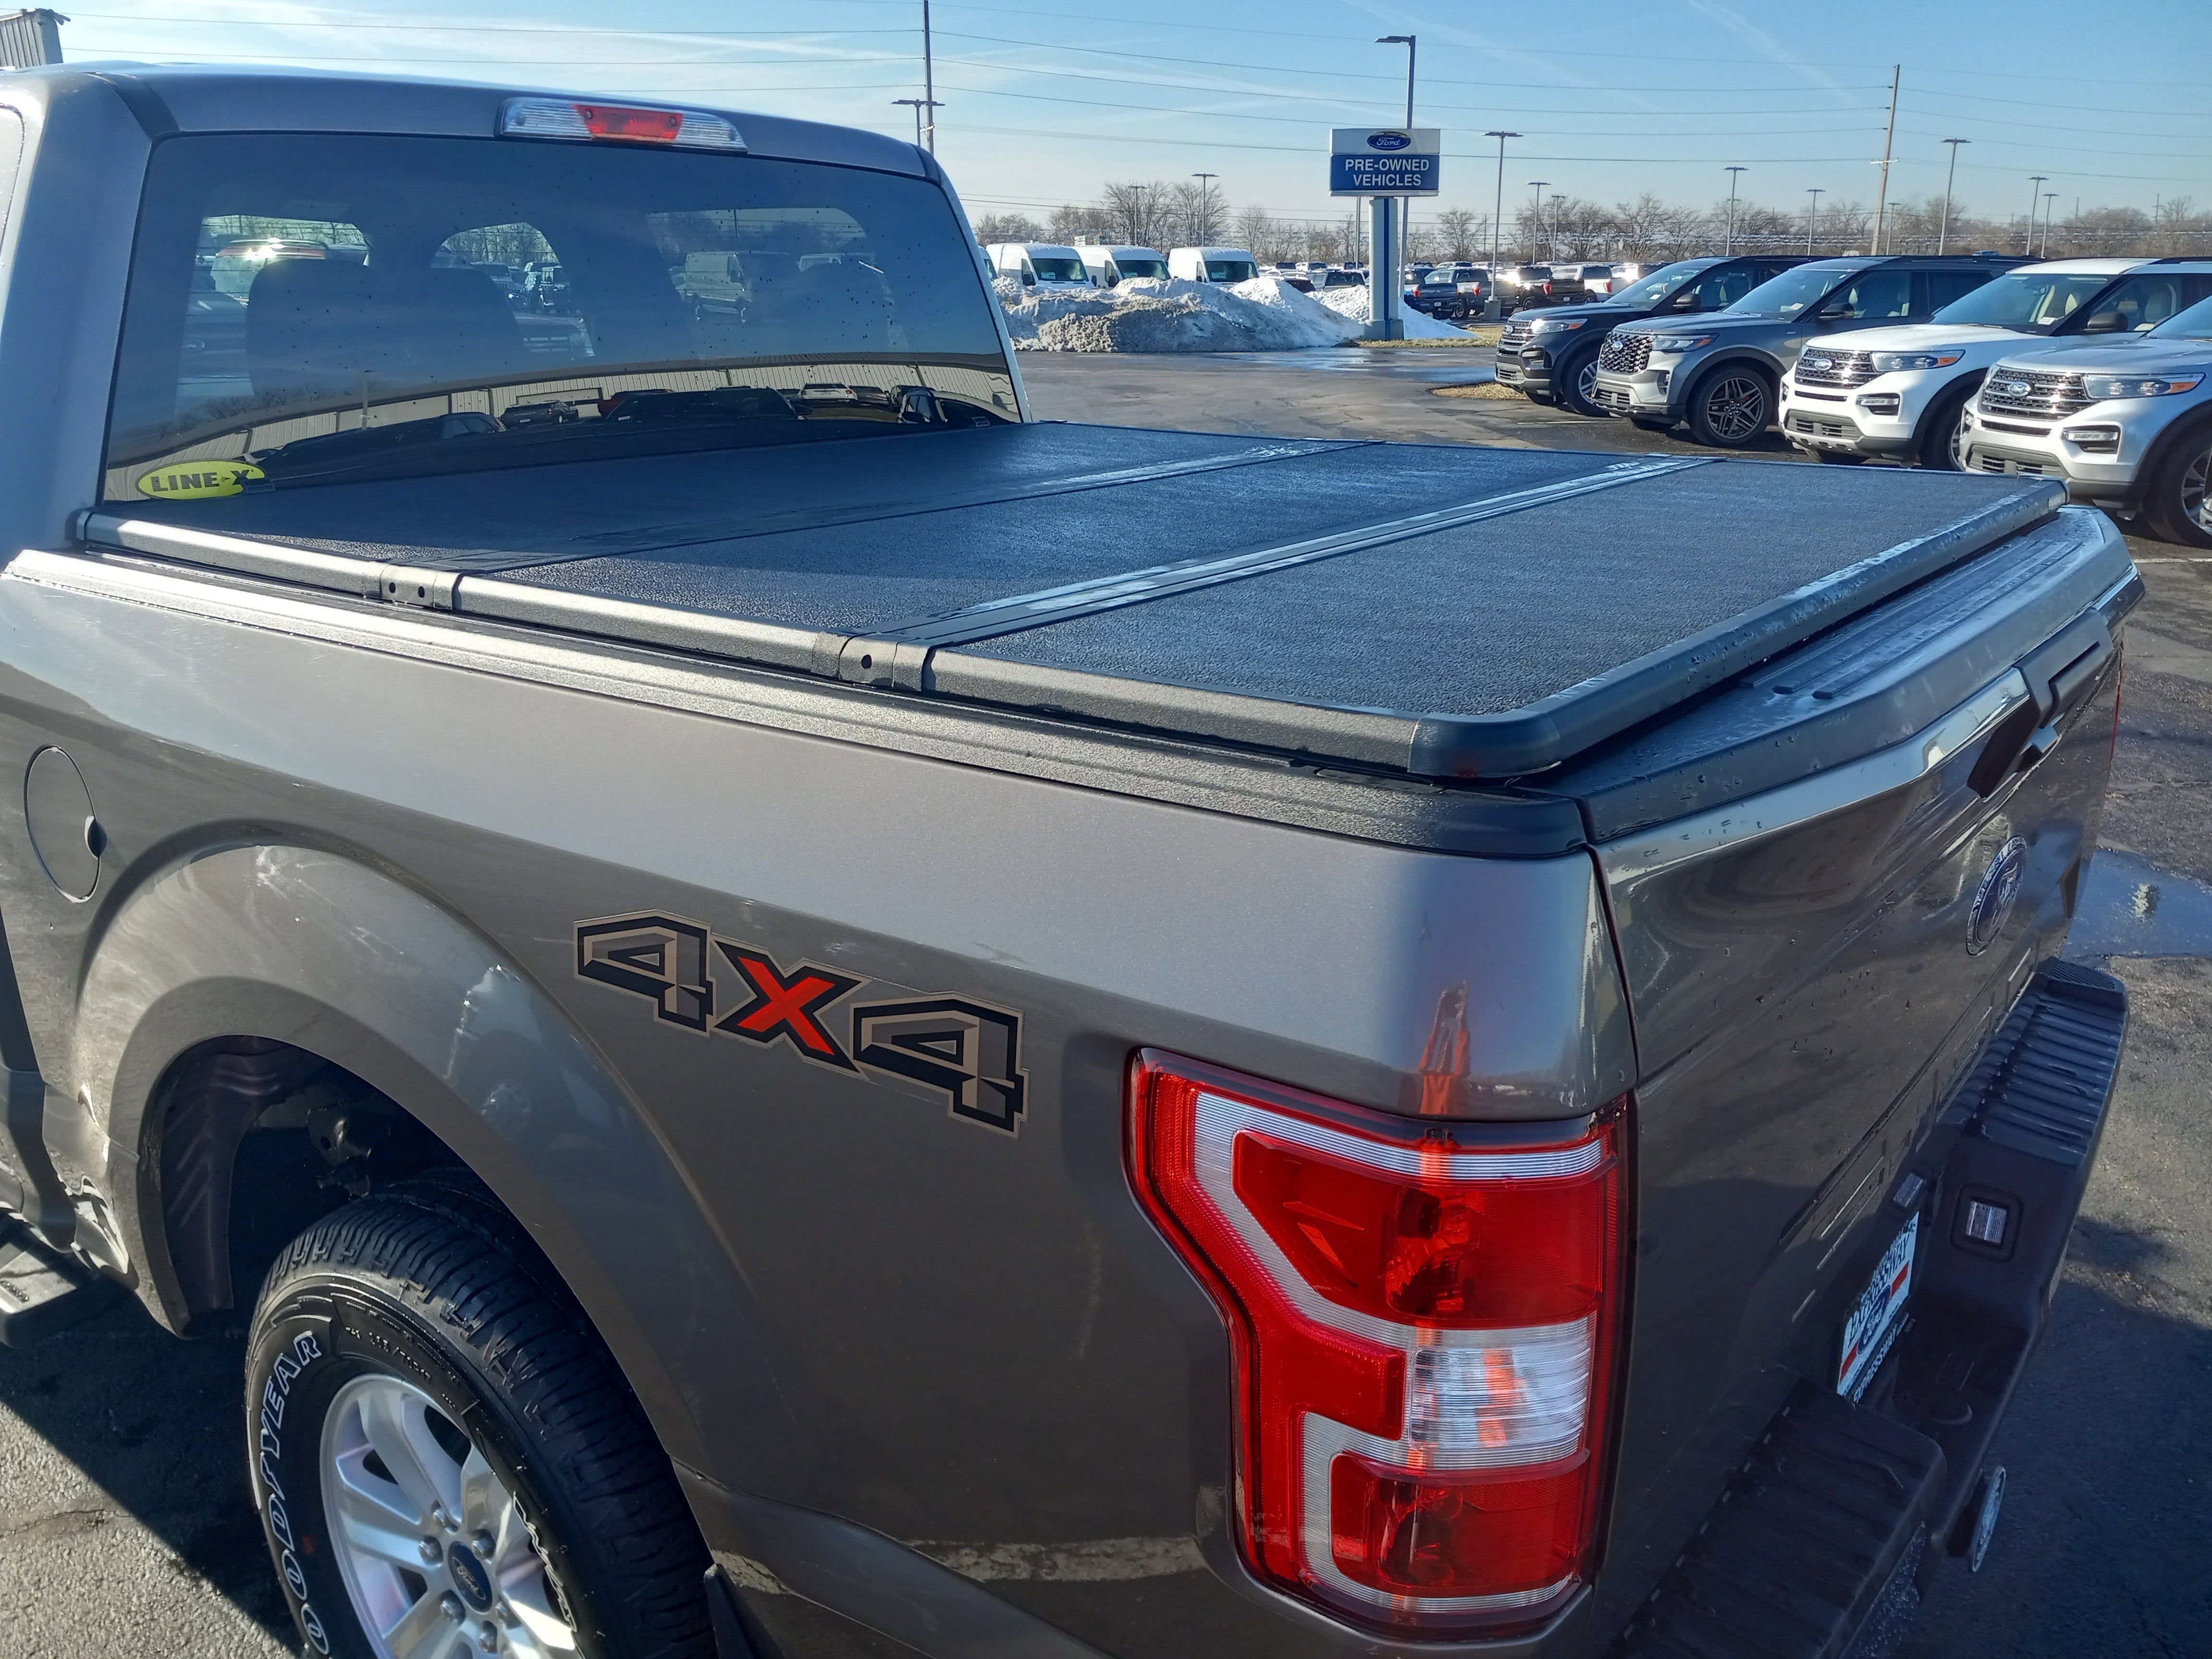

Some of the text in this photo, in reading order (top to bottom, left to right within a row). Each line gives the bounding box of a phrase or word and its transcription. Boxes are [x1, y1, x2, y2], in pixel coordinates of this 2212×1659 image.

[1376, 137, 1401, 146] Ford
[1345, 158, 1430, 171] PRE-OWNED
[1353, 173, 1421, 186] VEHICLES
[1853, 1323, 1898, 1404] EXPRESSWAY
